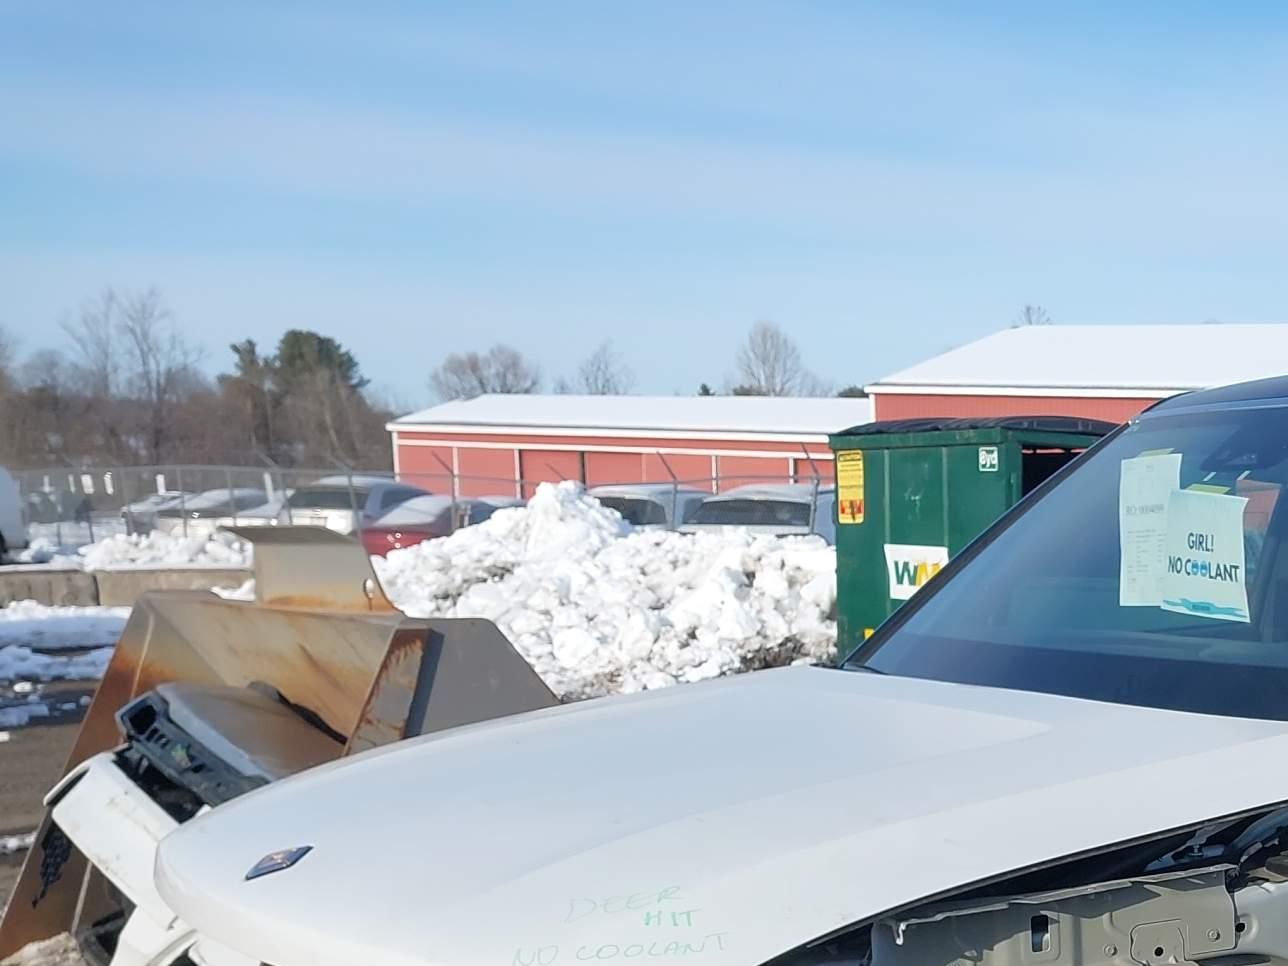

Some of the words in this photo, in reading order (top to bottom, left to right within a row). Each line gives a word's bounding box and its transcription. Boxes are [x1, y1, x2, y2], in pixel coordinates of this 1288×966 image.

[1187, 532, 1214, 553] GIRL!
[1167, 555, 1183, 575] NO
[1184, 559, 1240, 583] COOLANT
[563, 886, 686, 923] DEER
[644, 908, 703, 927] HIT
[576, 931, 729, 960] COOLANT
